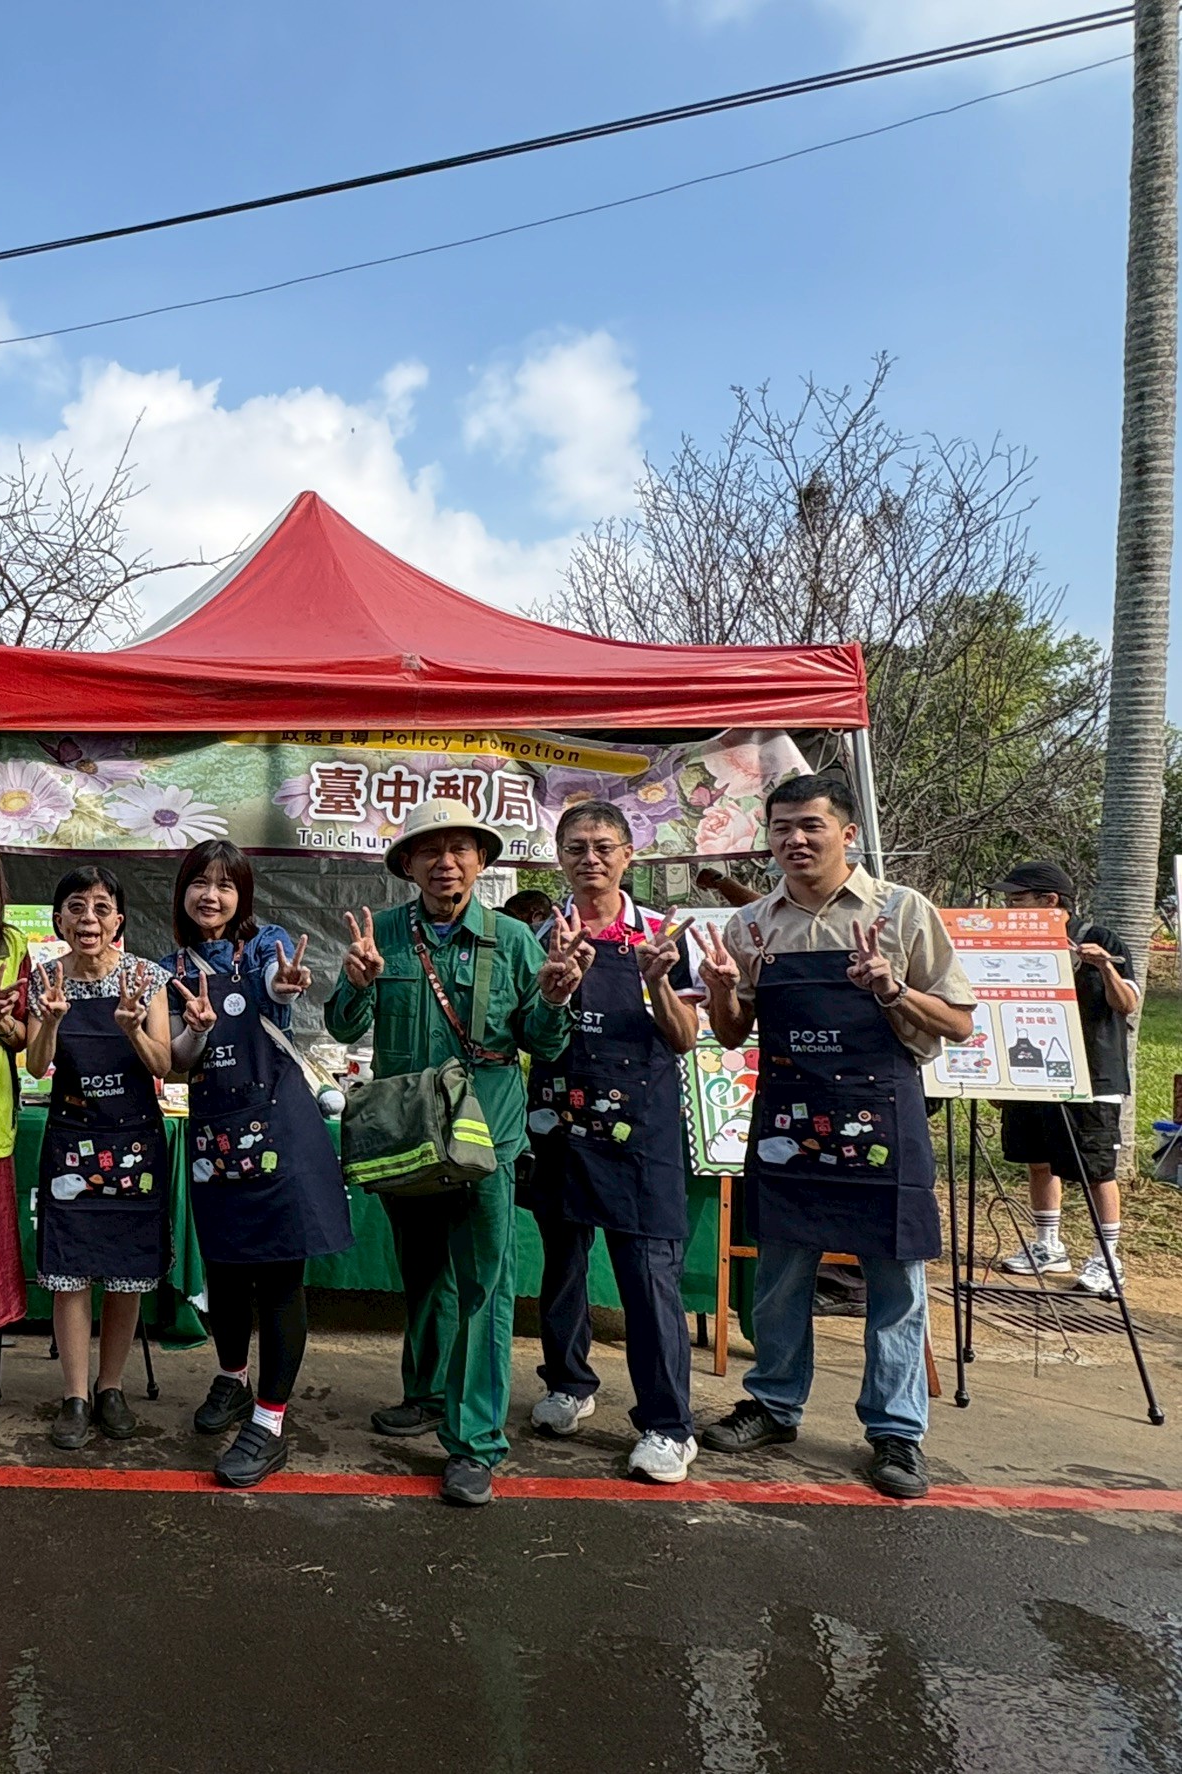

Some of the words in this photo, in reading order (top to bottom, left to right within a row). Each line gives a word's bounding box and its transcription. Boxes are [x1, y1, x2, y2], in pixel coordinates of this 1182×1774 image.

[382, 731, 452, 750] Policy
[464, 733, 581, 763] Promotion
[313, 766, 536, 827] 臺中郵局
[299, 829, 392, 849] Taichun
[509, 840, 554, 857] ffice
[573, 1009, 605, 1025] OST
[790, 1030, 841, 1043] POST
[80, 1073, 124, 1089] POST
